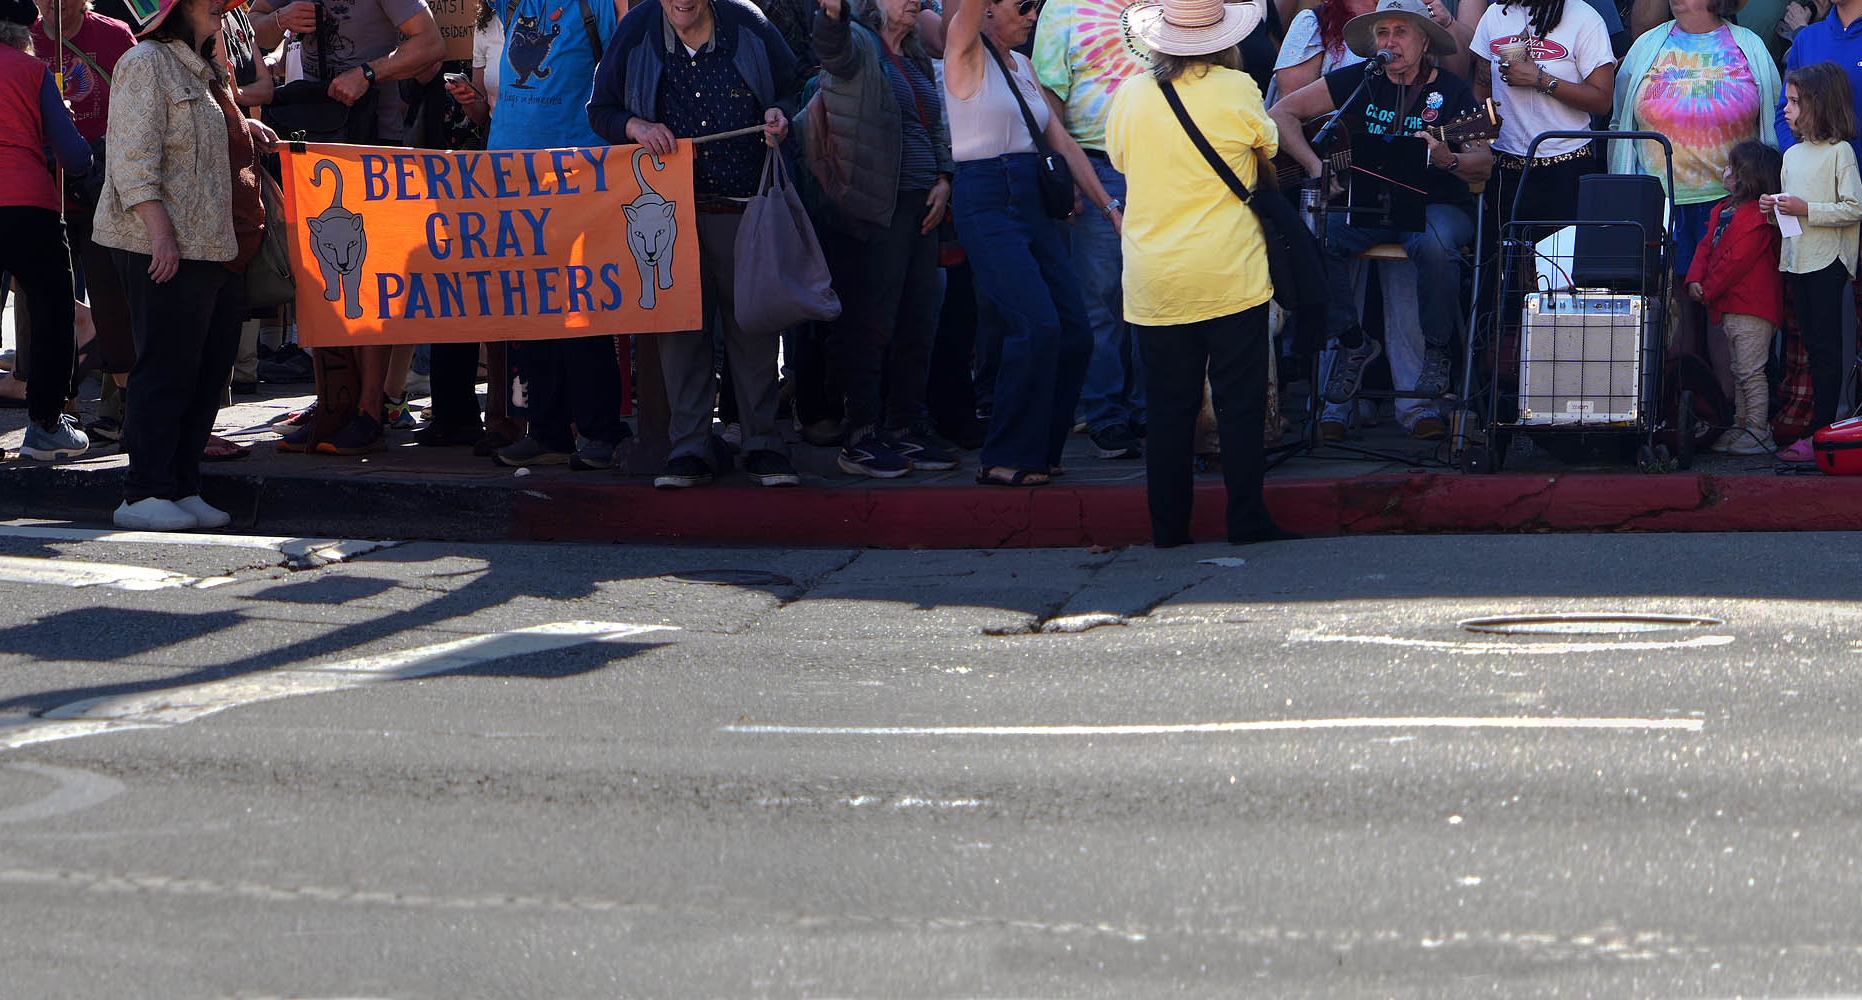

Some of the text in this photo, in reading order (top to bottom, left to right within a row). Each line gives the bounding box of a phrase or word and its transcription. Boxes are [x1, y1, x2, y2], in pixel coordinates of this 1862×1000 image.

[361, 147, 611, 200] BERKELEY
[425, 208, 552, 260] GRAY
[375, 263, 623, 319] PANTHERS
